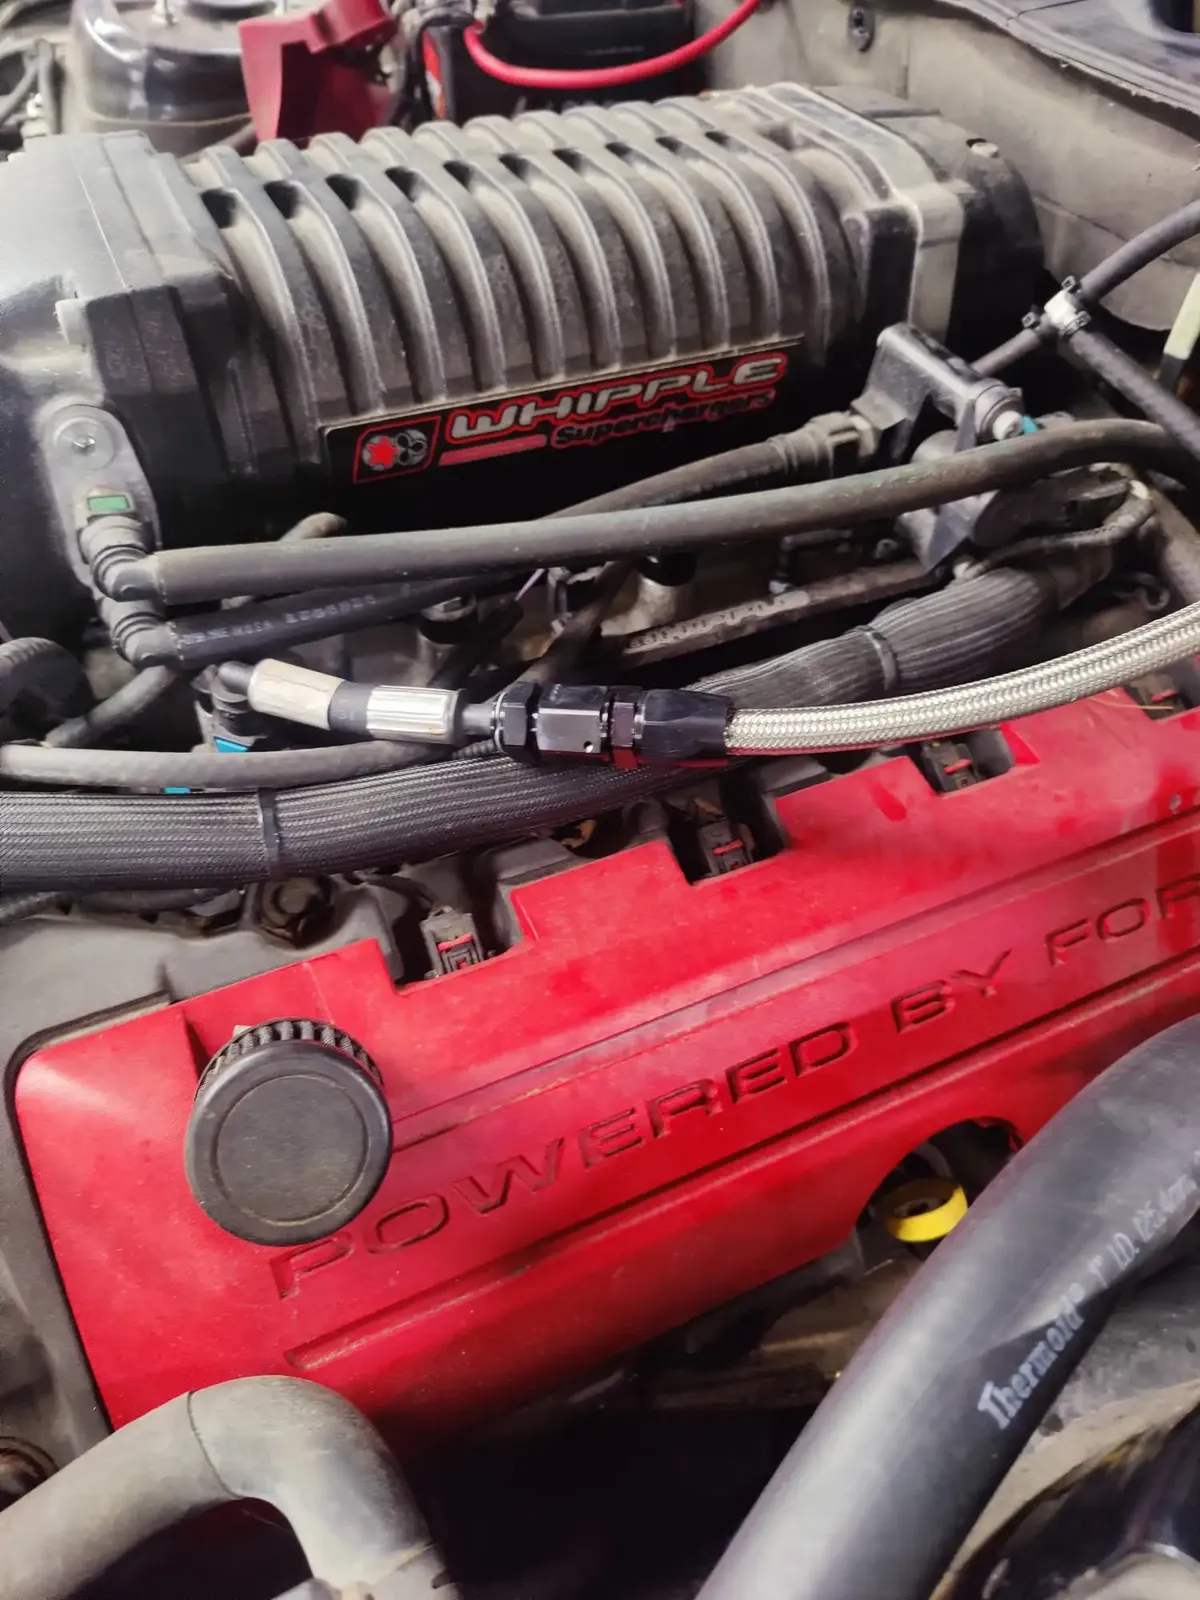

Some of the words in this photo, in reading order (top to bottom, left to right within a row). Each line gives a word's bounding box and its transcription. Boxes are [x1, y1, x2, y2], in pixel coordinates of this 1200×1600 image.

[448, 355, 786, 442] WHIPPLE
[270, 1021, 861, 1298] POWERED
[890, 949, 1013, 1036] BY
